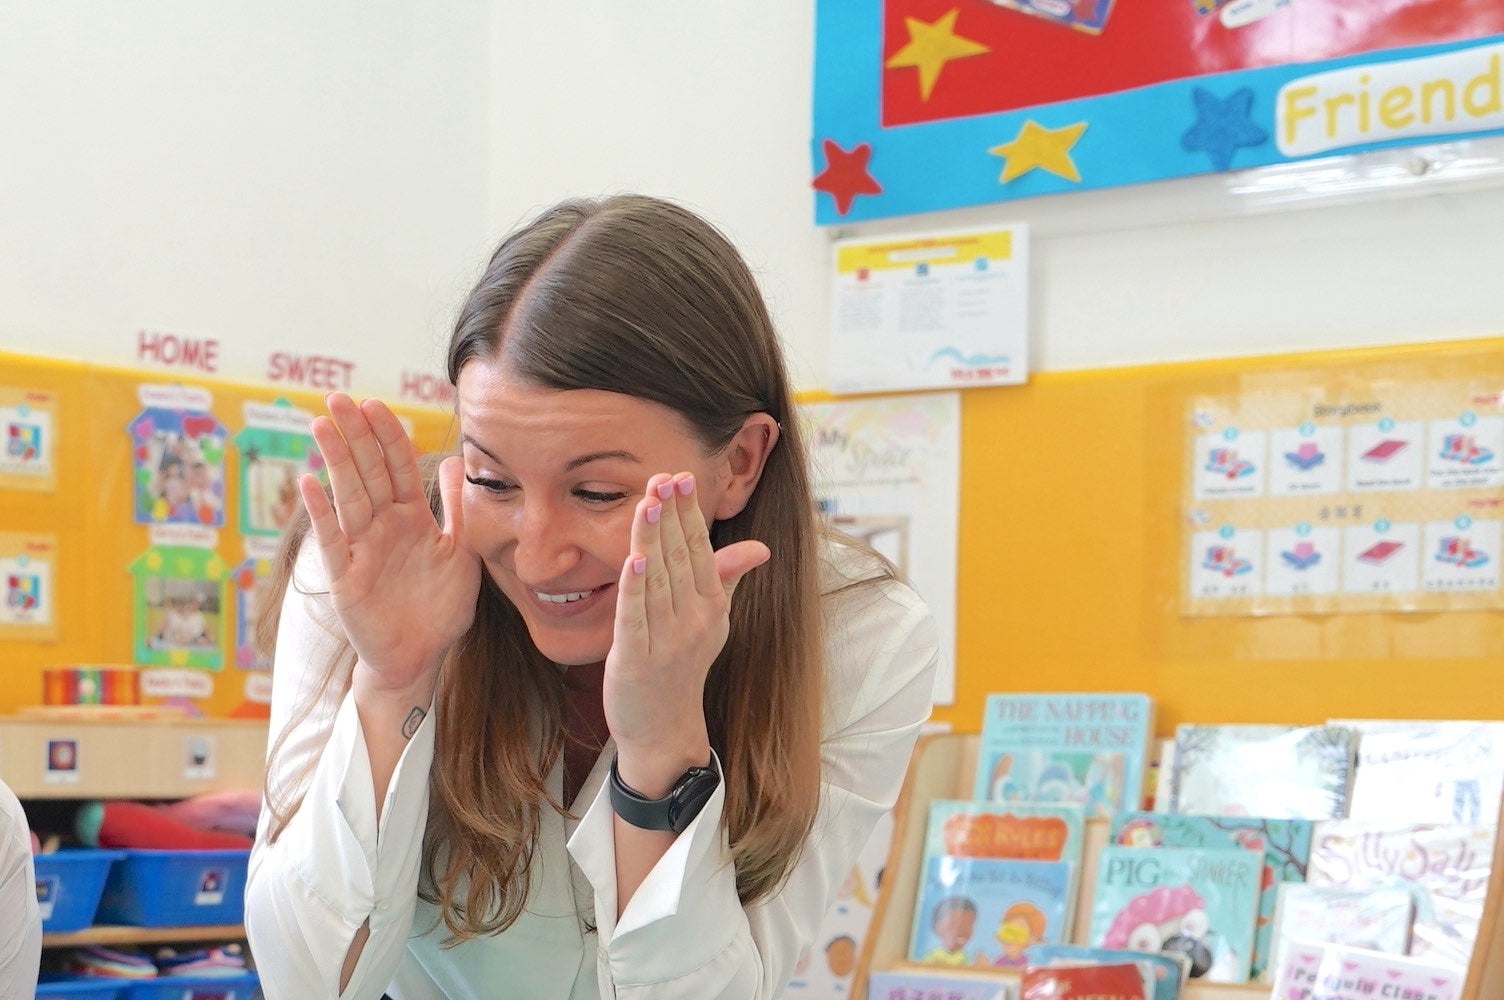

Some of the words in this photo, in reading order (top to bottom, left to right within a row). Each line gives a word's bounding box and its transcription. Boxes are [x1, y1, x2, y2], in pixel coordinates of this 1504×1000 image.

[137, 331, 220, 373] HOME
[267, 351, 356, 390] SWEET
[998, 701, 1038, 722] THE
[1063, 727, 1138, 746] HOUSE
[1105, 856, 1161, 887] PIG
